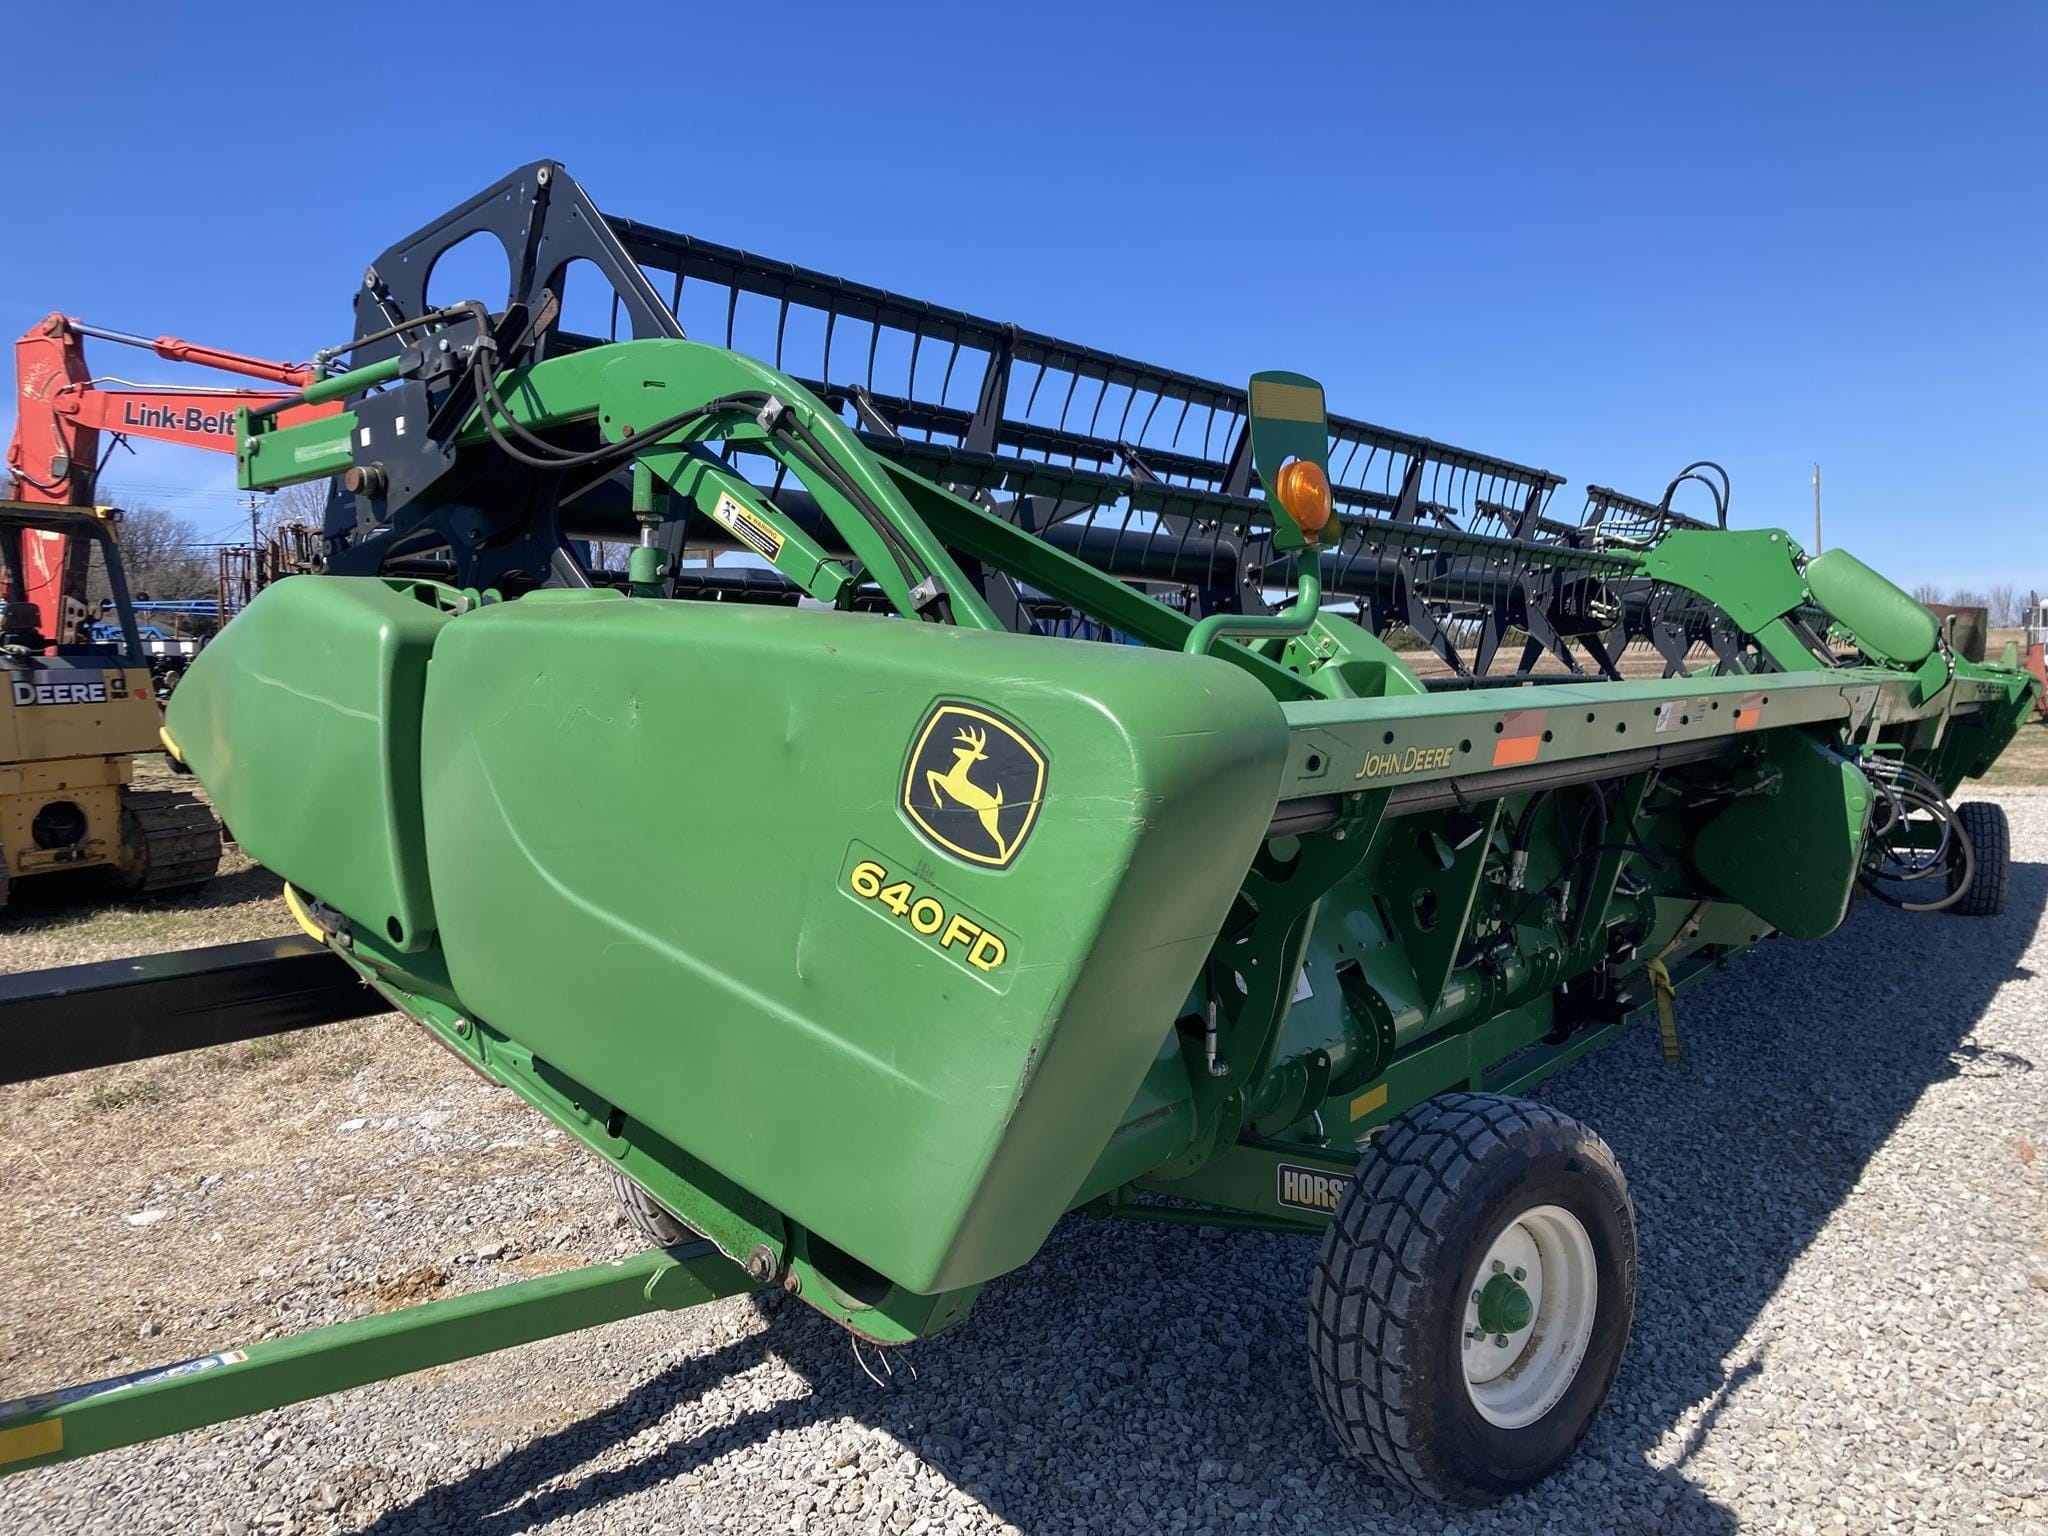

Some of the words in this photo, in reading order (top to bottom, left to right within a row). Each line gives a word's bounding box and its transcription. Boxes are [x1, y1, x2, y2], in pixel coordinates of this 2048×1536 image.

[124, 401, 238, 436] Link-Belt
[752, 516, 778, 540] WARNING
[13, 682, 107, 705] DEERE
[1355, 750, 1403, 780] JOHN
[1402, 746, 1454, 773] DEERE
[850, 860, 1008, 971] 640FD
[1284, 1170, 1348, 1209] HORS
